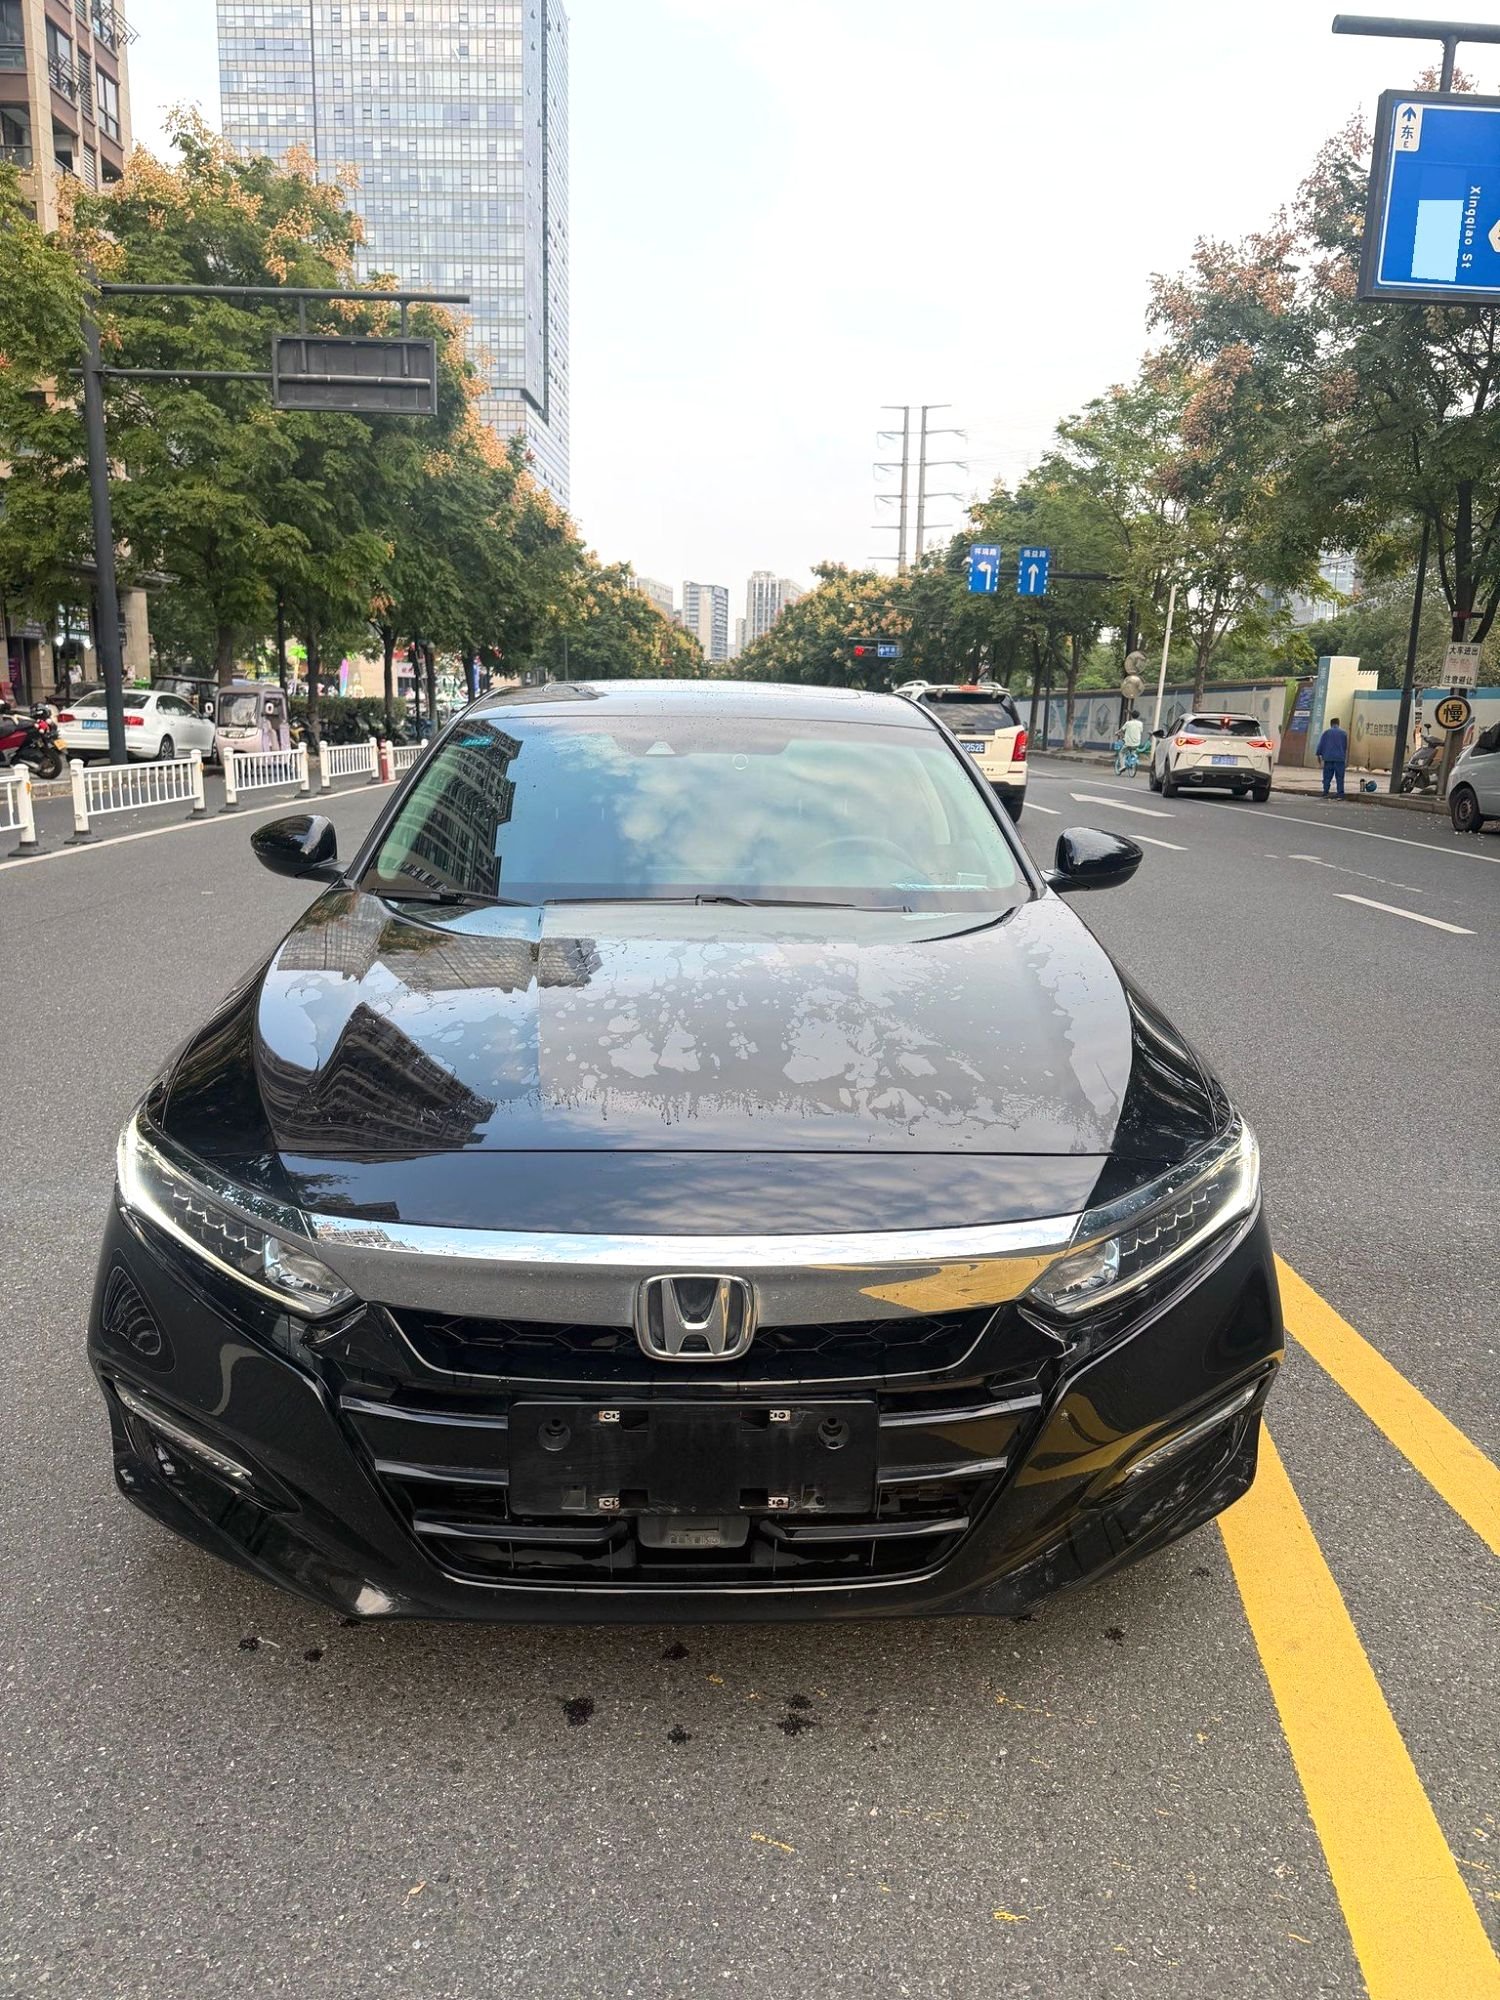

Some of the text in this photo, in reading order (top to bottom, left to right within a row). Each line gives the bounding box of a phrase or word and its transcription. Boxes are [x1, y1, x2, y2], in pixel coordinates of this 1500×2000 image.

[1400, 125, 1414, 140] 东
[1461, 185, 1482, 268] Xingqiao St
[1449, 645, 1479, 656] 大车进出
[1443, 703, 1463, 723] 慢
